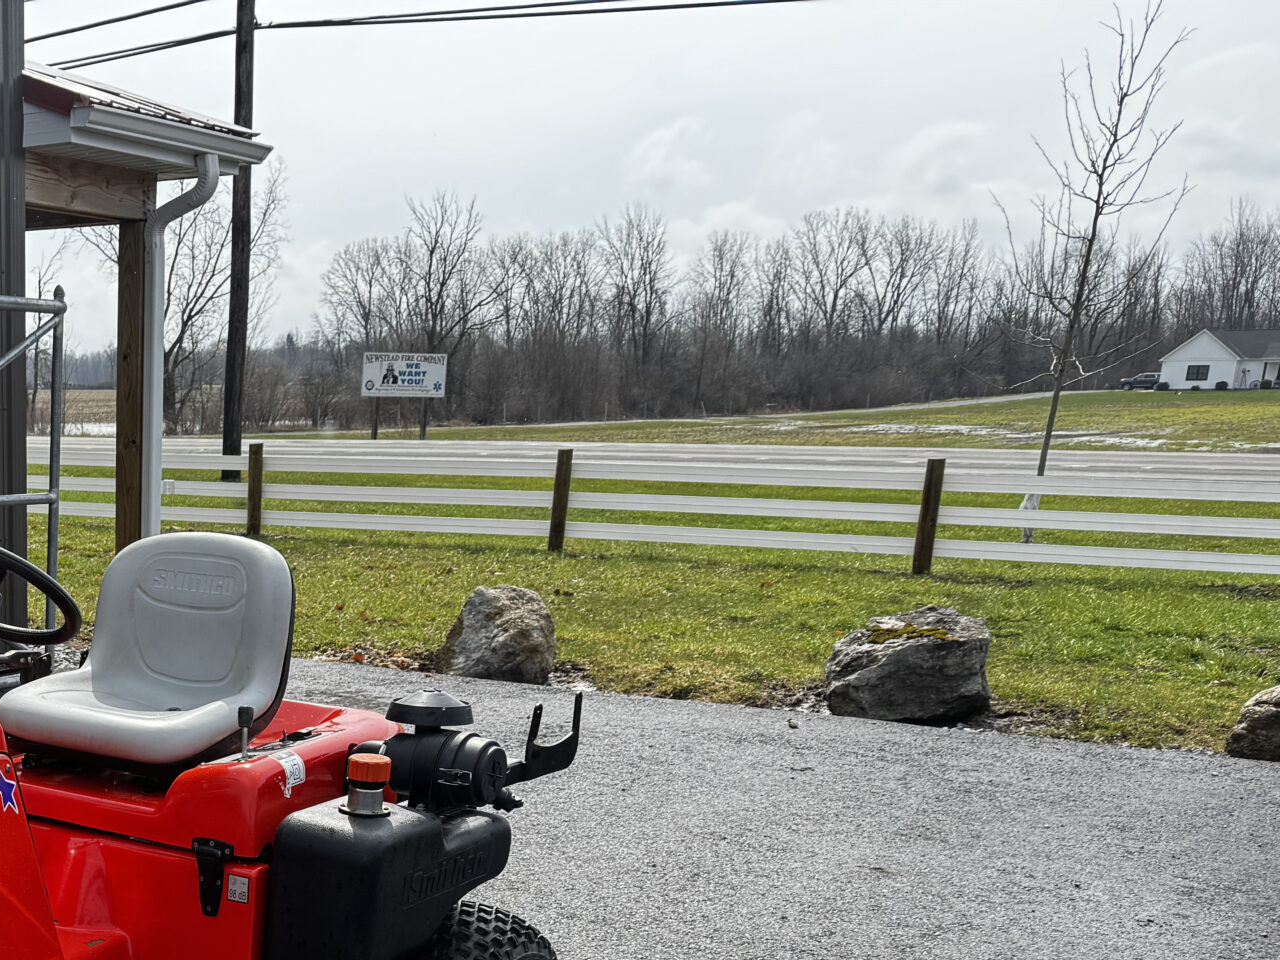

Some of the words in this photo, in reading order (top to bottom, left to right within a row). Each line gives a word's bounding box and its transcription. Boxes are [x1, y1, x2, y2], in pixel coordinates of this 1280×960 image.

[365, 354, 400, 364] NEWSTEAD
[401, 354, 415, 362] FIRE
[416, 355, 447, 366] COMPANY
[398, 370, 427, 378] WANT
